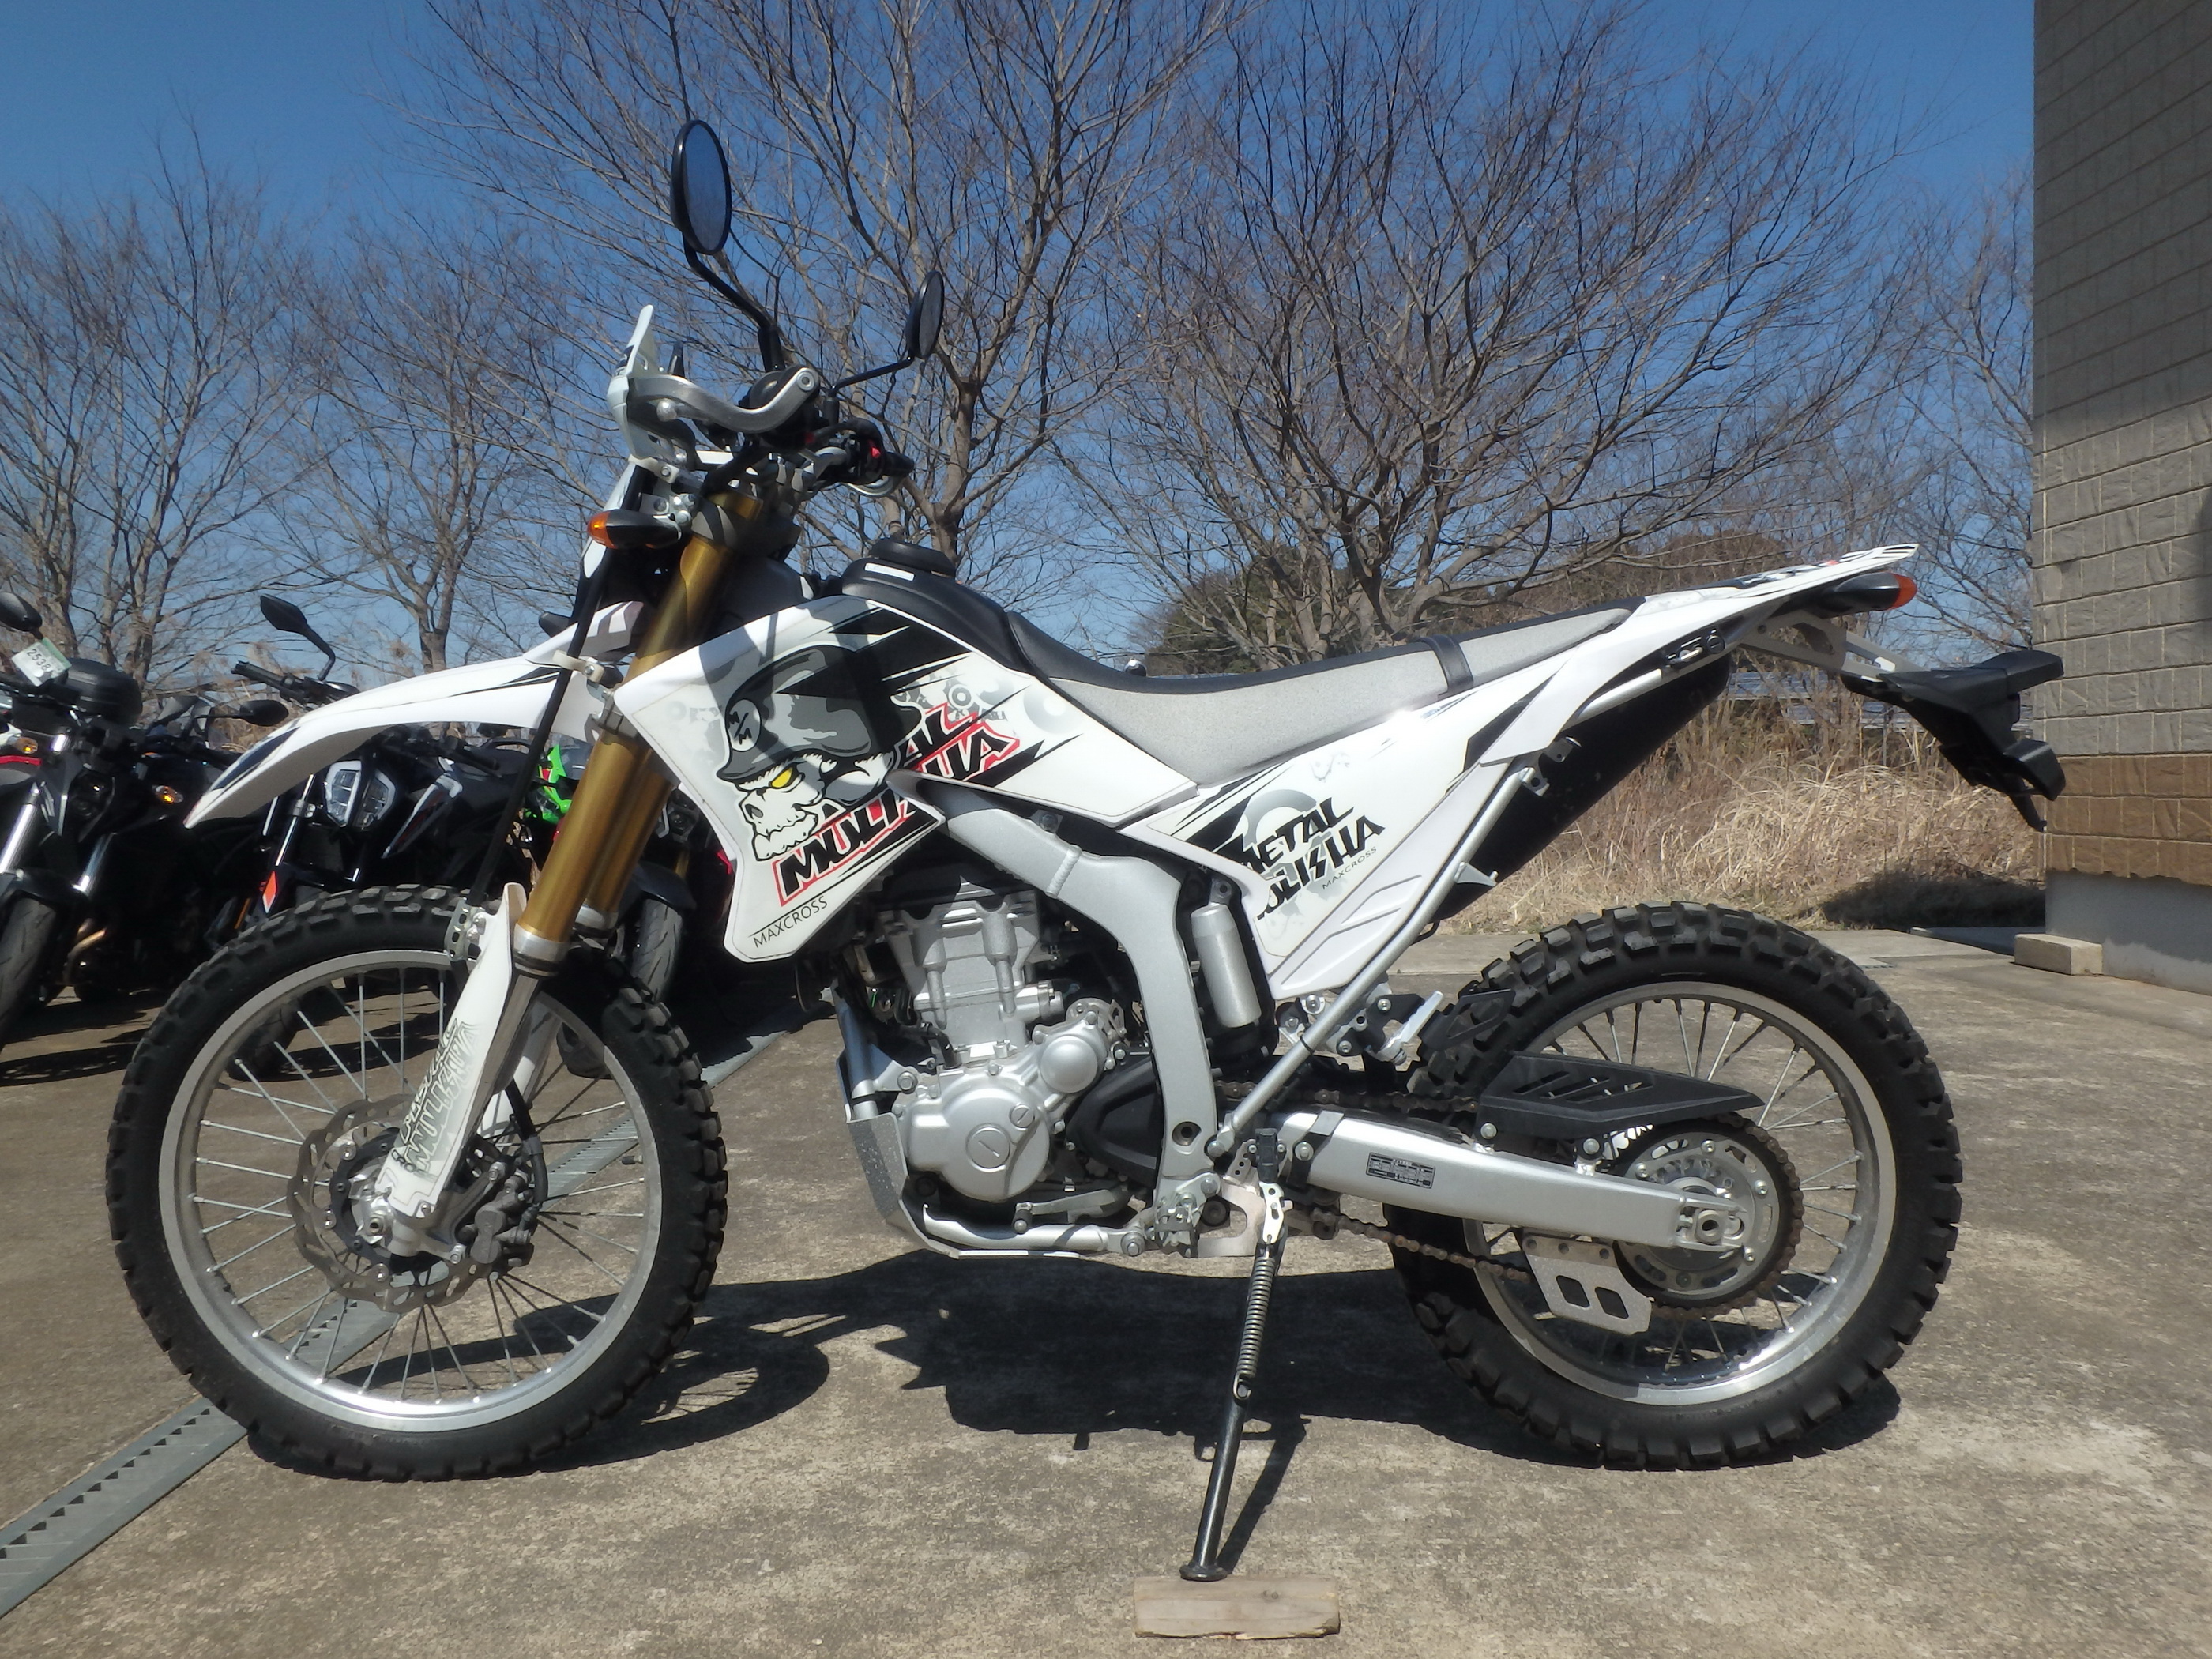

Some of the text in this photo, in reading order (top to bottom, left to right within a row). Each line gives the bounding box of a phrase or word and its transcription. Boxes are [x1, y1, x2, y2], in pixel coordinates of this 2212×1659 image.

[26, 649, 51, 671] 2538
[1257, 814, 1386, 920] ULISHA
[1322, 845, 1377, 890] MAXCROSS
[753, 895, 828, 948] MAXCROSS
